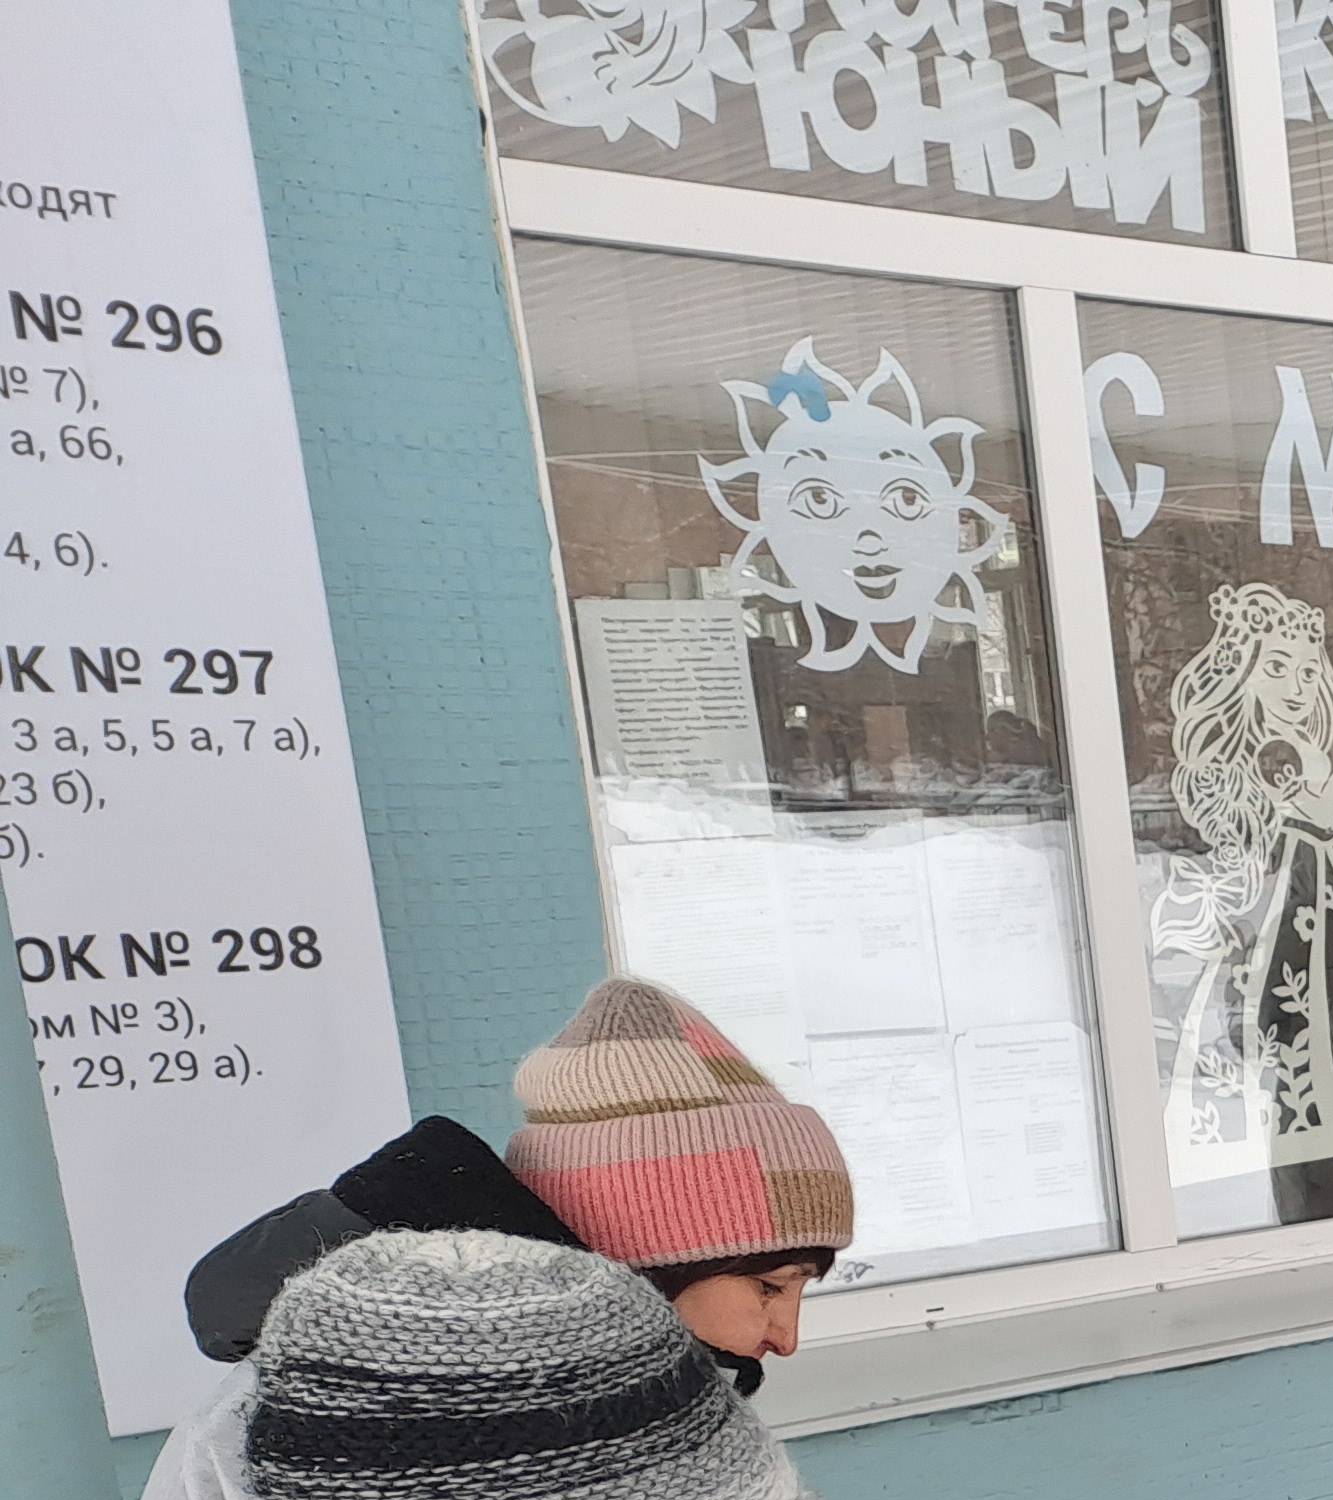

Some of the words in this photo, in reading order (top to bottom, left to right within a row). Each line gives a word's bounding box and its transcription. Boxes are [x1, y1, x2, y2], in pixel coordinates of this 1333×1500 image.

[746, 27, 1208, 234] ЮНЫЙ
[0, 181, 117, 222] одят
[9, 290, 83, 343] №
[106, 300, 223, 356] 296
[43, 366, 100, 414] 7),
[60, 424, 124, 467] 66,
[4, 531, 41, 572] 4,
[54, 530, 109, 577] 6).
[0, 645, 55, 693] К
[70, 646, 142, 694] №
[164, 648, 274, 695] 297
[11, 718, 39, 752] 3
[53, 725, 90, 757] а,
[103, 719, 139, 757] 5,
[152, 719, 175, 752] 5
[190, 724, 224, 757] а,
[233, 719, 257, 752] 7
[273, 716, 322, 761] а),
[52, 768, 106, 813] б),
[15, 933, 106, 982] ОК
[120, 930, 191, 979] №
[211, 925, 323, 972] 298
[90, 1002, 139, 1037] №
[154, 996, 207, 1040] 3),
[72, 1055, 138, 1092] 29,
[148, 1050, 200, 1085] 29
[214, 1043, 264, 1087] а).
